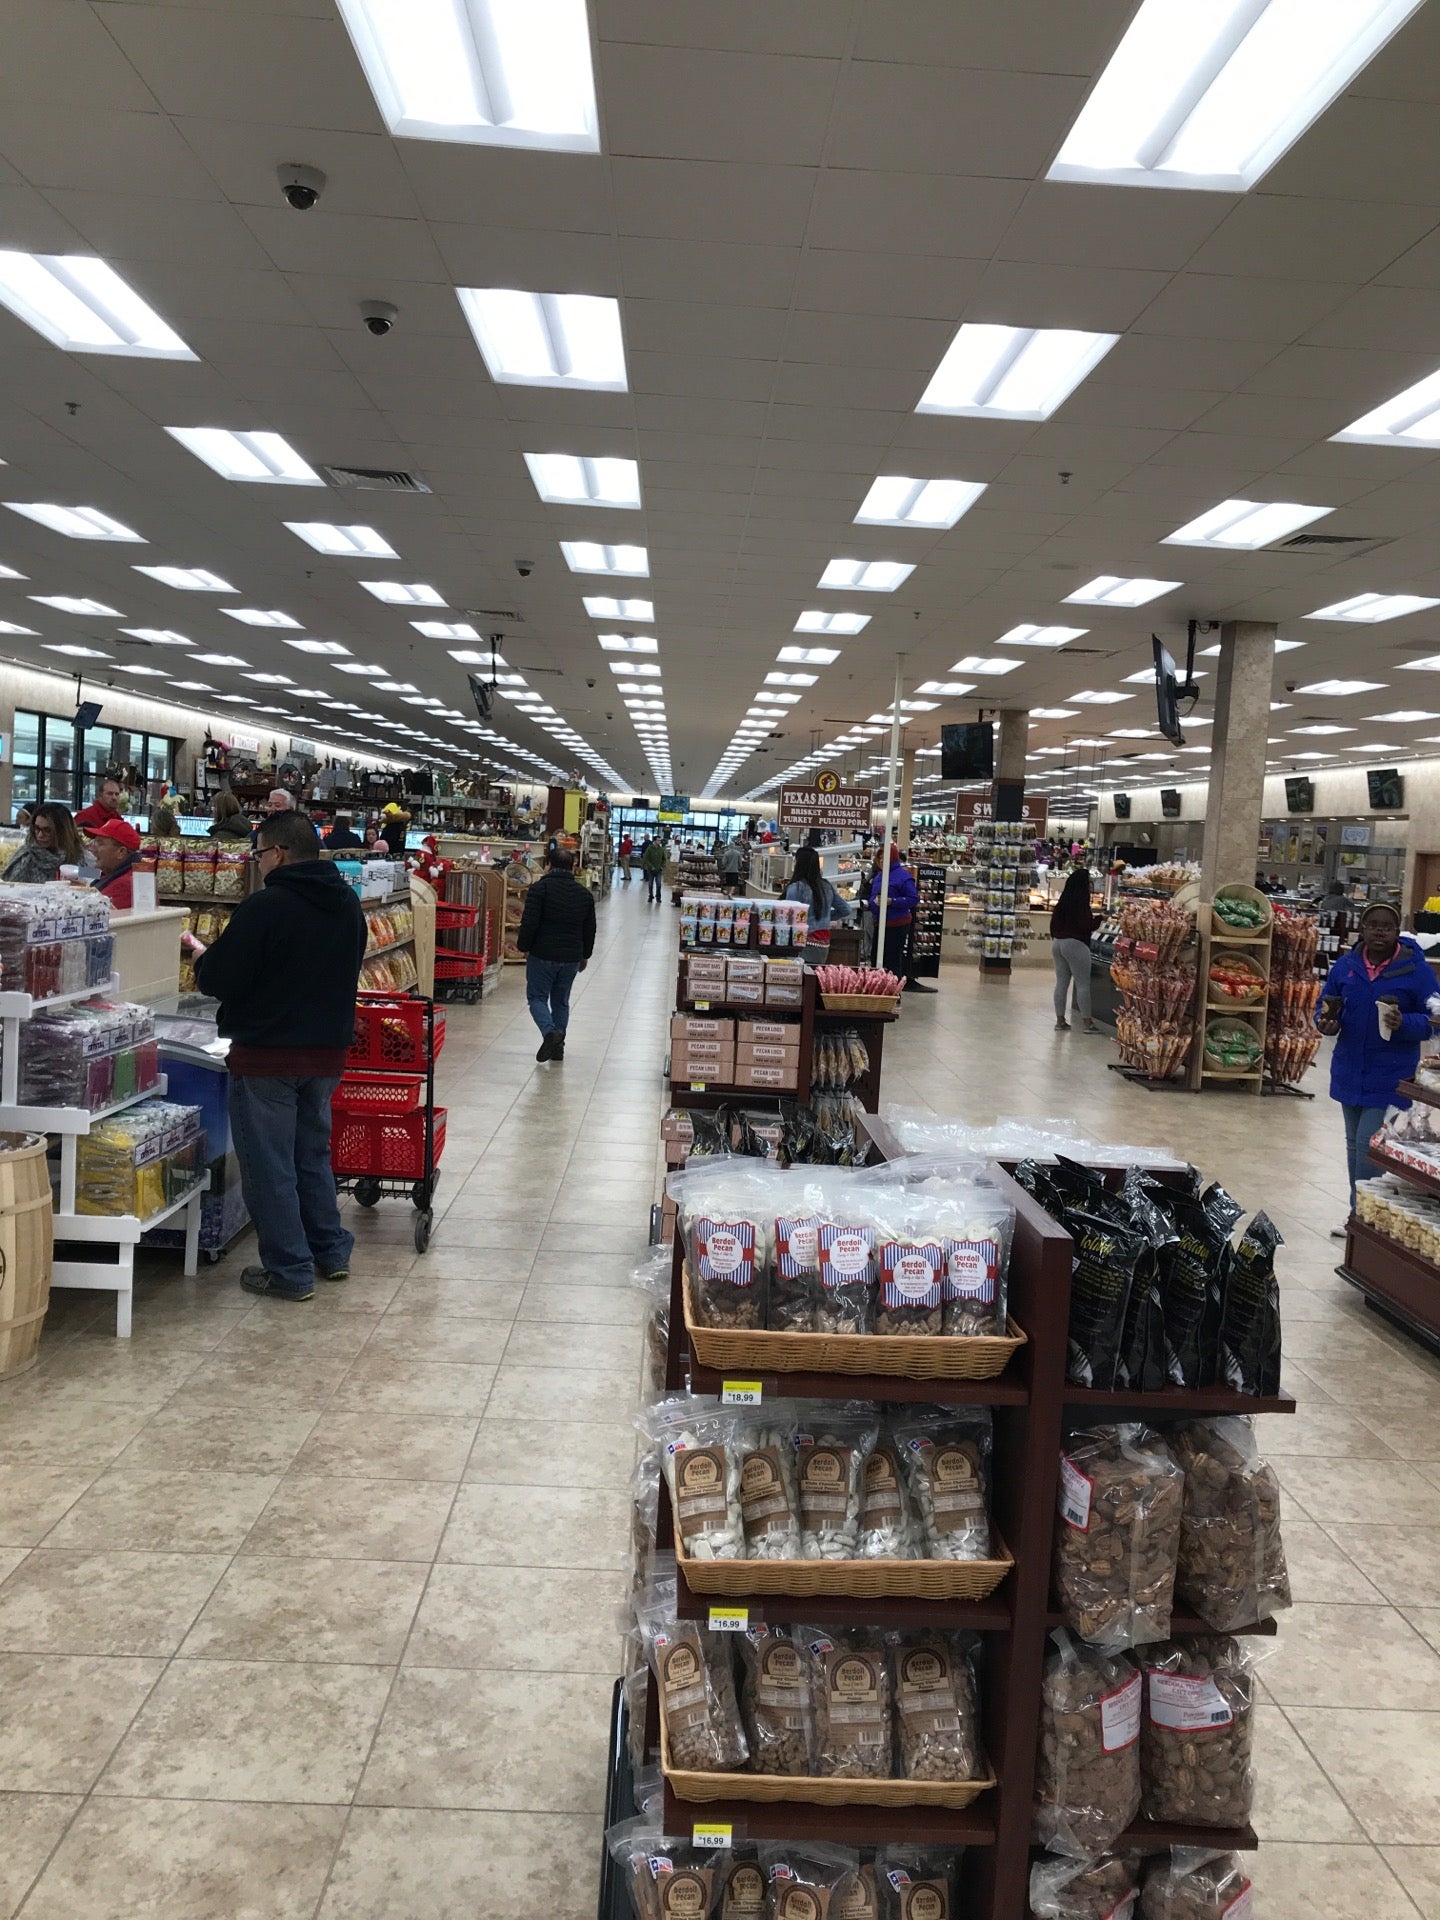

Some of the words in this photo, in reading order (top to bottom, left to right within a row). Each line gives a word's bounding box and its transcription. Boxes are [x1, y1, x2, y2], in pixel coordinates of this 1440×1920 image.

[783, 791, 817, 804] TEXAS
[818, 793, 853, 806] ROUND
[855, 795, 869, 807] UP
[791, 808, 822, 816] BRISKET
[828, 810, 861, 818] SAUSAGE
[972, 802, 1030, 818] SWS
[819, 817, 846, 825] PULLED
[712, 1237, 736, 1246] Berdoll
[713, 1244, 733, 1252] Pecan
[954, 1254, 980, 1263] Berdoll
[901, 1261, 927, 1269] Berdoll
[956, 1261, 978, 1269] Pecan
[814, 1464, 833, 1472] Pecan
[673, 1660, 690, 1670] Pecan
[774, 1659, 794, 1667] Pecan
[673, 1886, 698, 1894] Berdoll
[675, 1893, 696, 1901] Pecan
